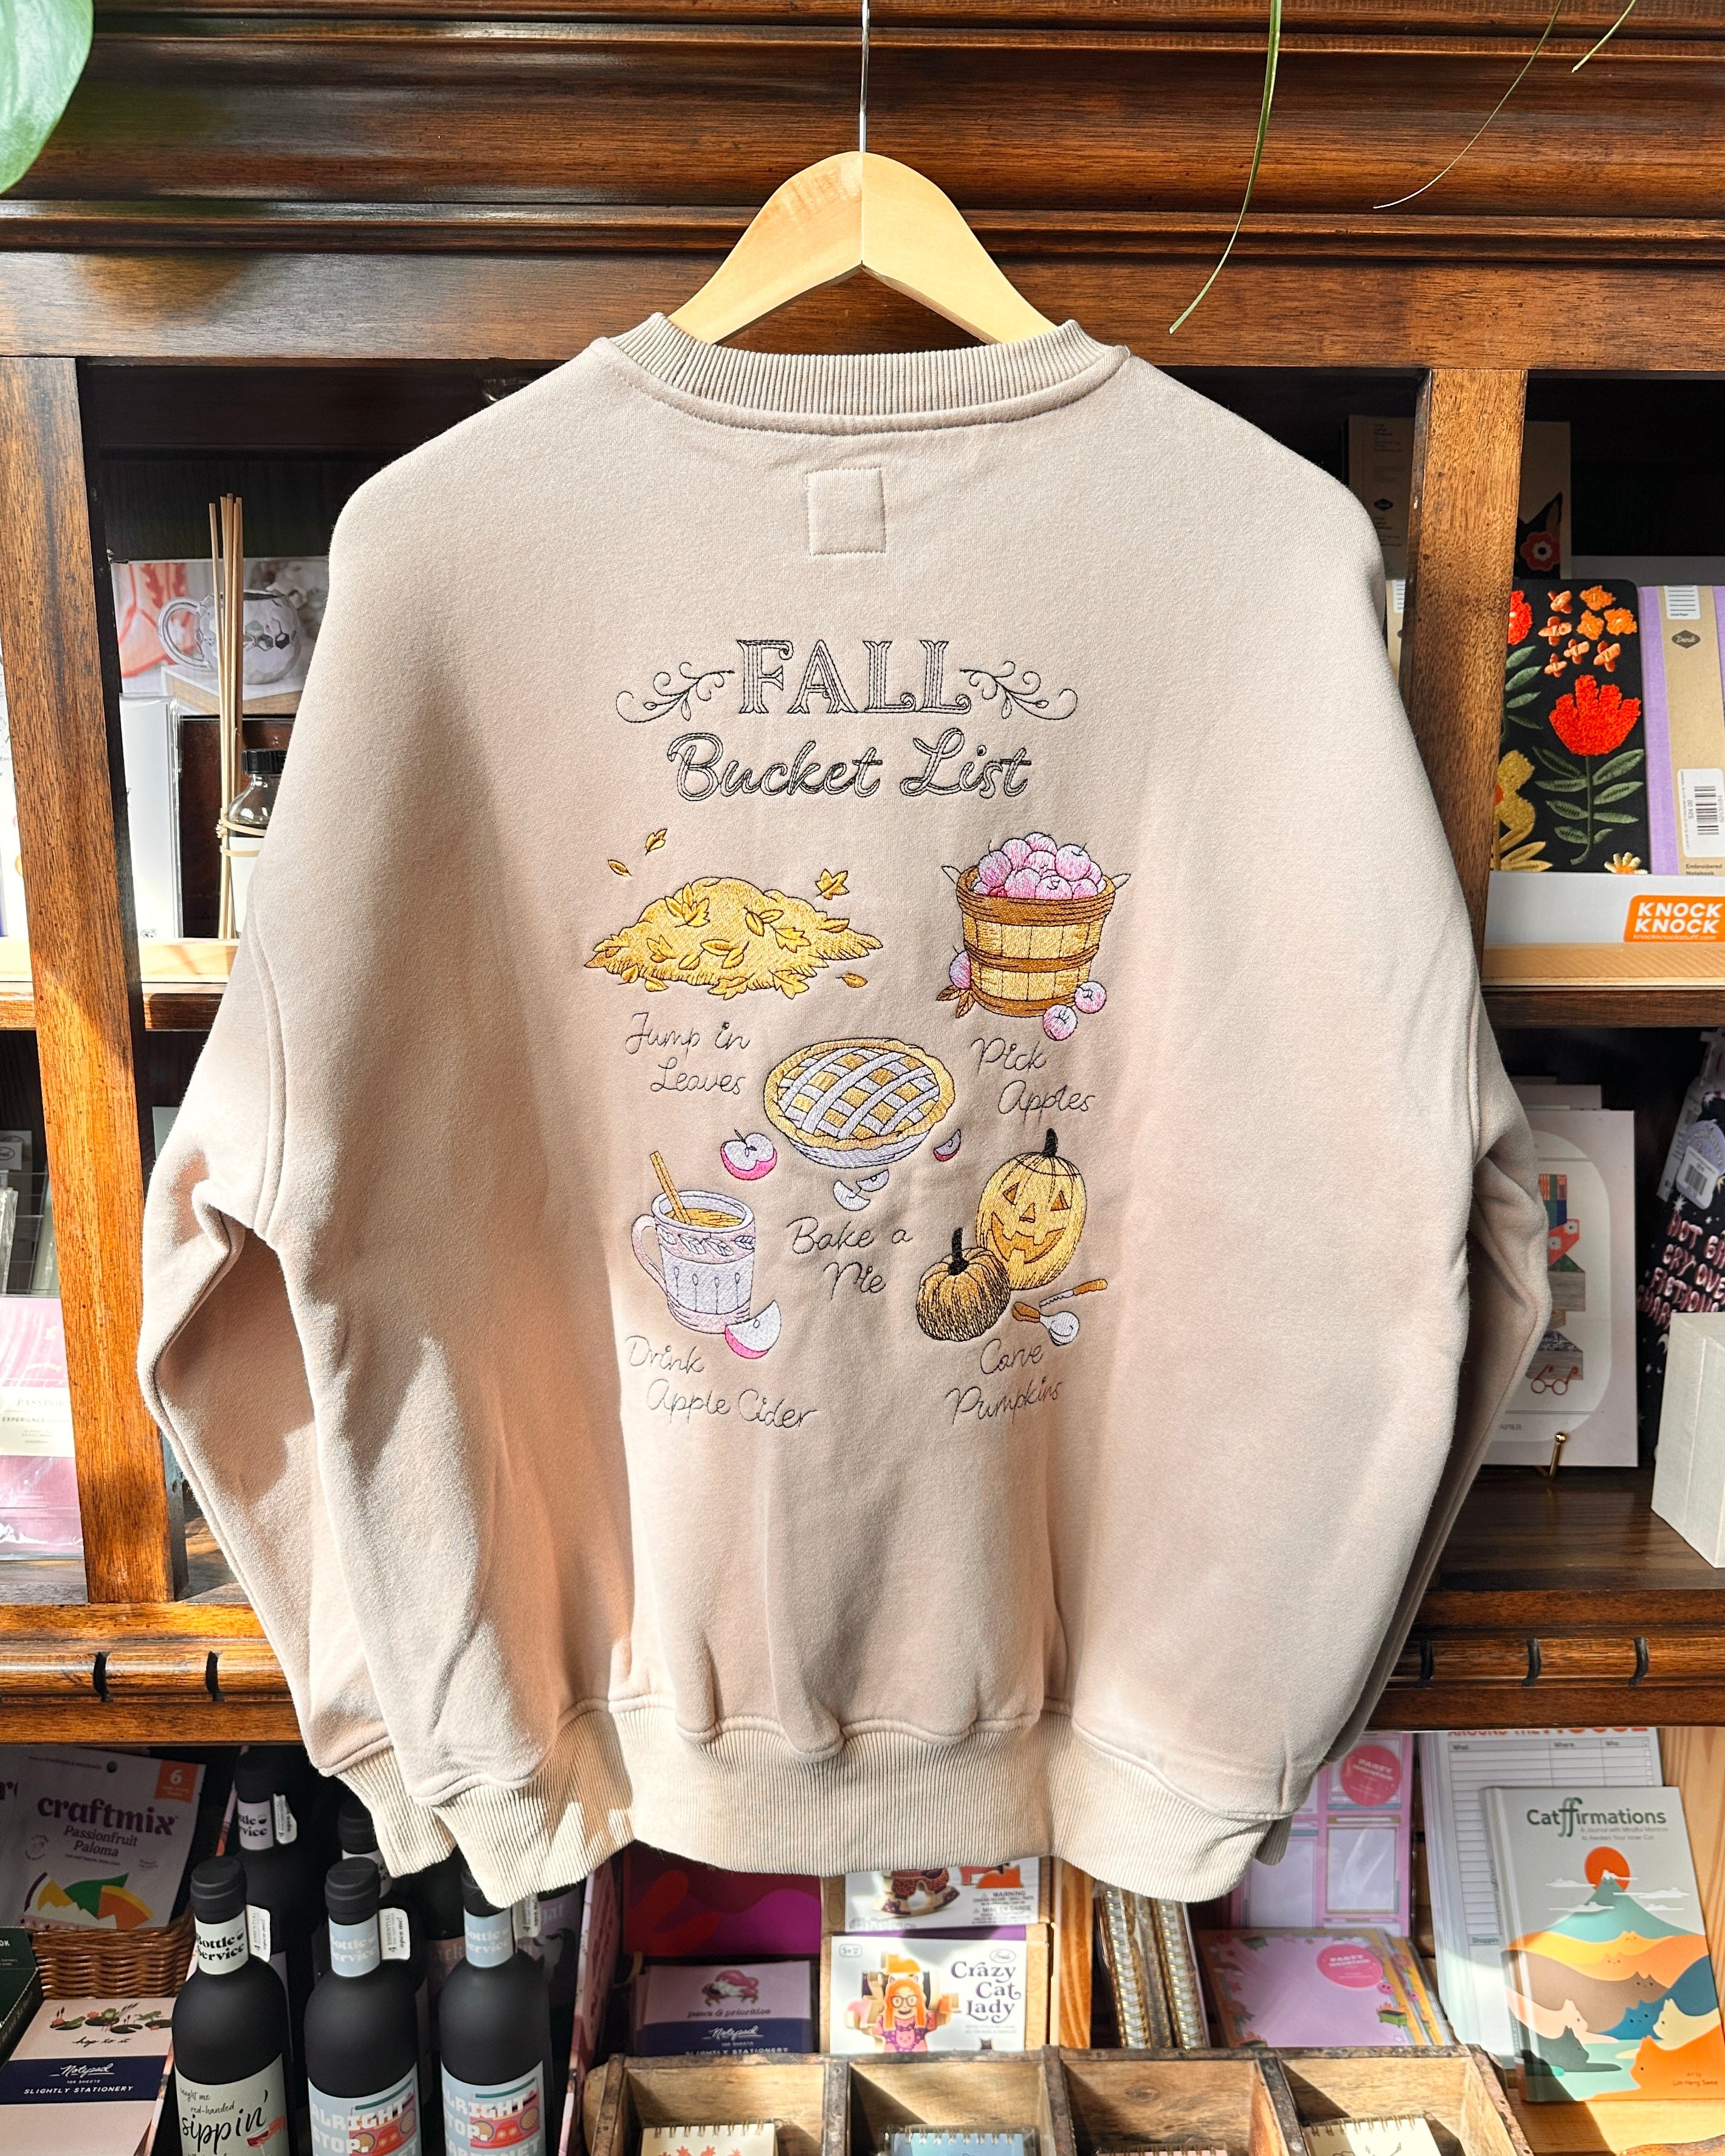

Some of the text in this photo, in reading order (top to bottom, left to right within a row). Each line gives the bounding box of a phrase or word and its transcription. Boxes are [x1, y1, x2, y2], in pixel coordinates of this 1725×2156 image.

[737, 639, 971, 714] FALL
[667, 728, 1031, 801] Bucket List
[1637, 902, 1723, 918] KNOCK
[1634, 918, 1720, 934] KNOCK
[625, 1012, 751, 1060] Jump in
[971, 1038, 1046, 1075] Pick
[650, 1057, 746, 1095] Leaves
[998, 1080, 1095, 1124] Apples
[787, 1216, 913, 1254] Bake a
[824, 1262, 886, 1300] Pie
[625, 1335, 704, 1374] Drink
[980, 1338, 1044, 1374] Carve
[647, 1379, 818, 1428] Apple Cider
[946, 1376, 1062, 1424] Pumpkins
[170, 1769, 183, 1784] 6
[38, 1796, 176, 1836] craftmix
[238, 1814, 256, 1825] ttle
[1526, 1797, 1667, 1837] Catffirmations
[64, 1825, 138, 1847] Passionfruit
[239, 1826, 267, 1837] vice
[74, 1839, 120, 1858] Paloma
[196, 1934, 235, 1950] Bottle
[198, 1943, 245, 1961] Service
[1329, 1954, 1363, 1963] PARTY
[951, 1961, 1016, 1983] Crazy
[976, 1982, 1022, 2000] Cat
[966, 1999, 1016, 2024] Lady
[72, 2036, 97, 2047] hop
[708, 2025, 759, 2040] Notepad
[731, 2047, 789, 2055] STATIONERY
[60, 2062, 114, 2078] Notepad
[190, 2101, 235, 2115] red-handed
[311, 2099, 405, 2130] ALRIGHT
[313, 2126, 370, 2154] STOP.
